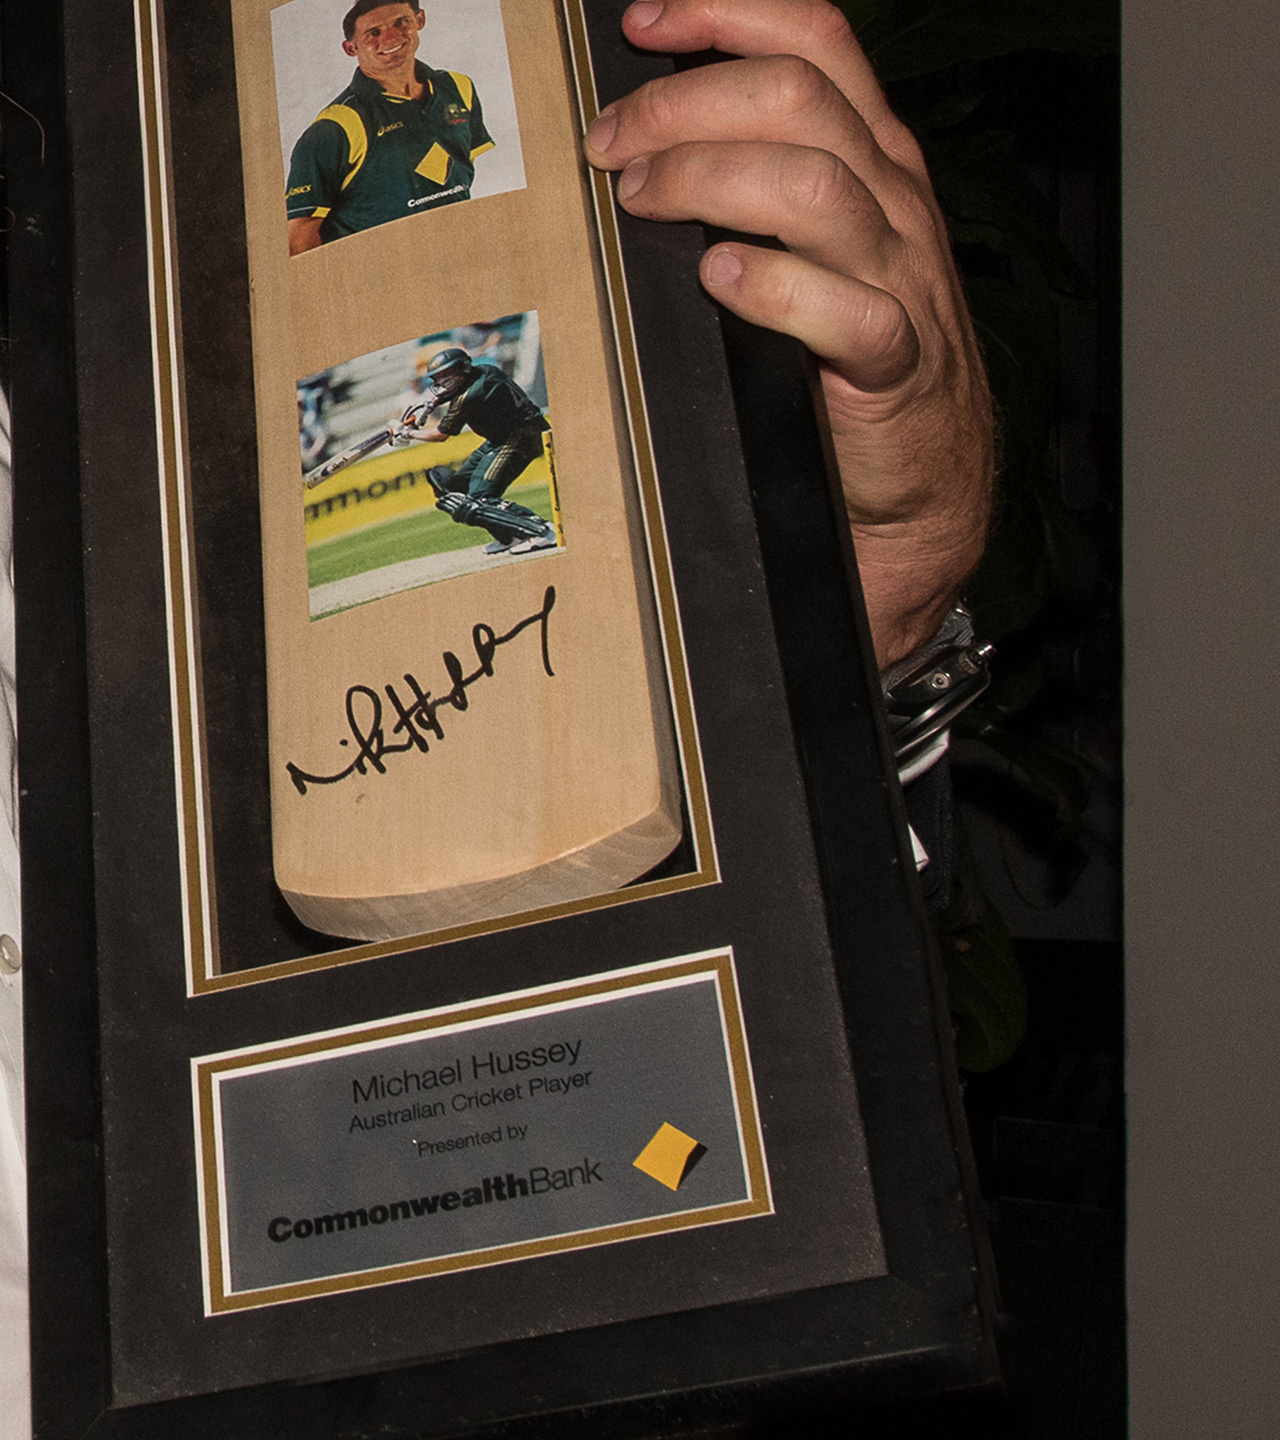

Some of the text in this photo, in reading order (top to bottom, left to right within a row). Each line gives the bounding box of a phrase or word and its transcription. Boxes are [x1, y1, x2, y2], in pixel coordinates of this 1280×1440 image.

[348, 1070, 593, 1134] Australian Cricket Player
[352, 1039, 583, 1104] Michael Hussey
[417, 1124, 528, 1157] Presented by
[267, 1157, 604, 1243] CommonwealthBank
